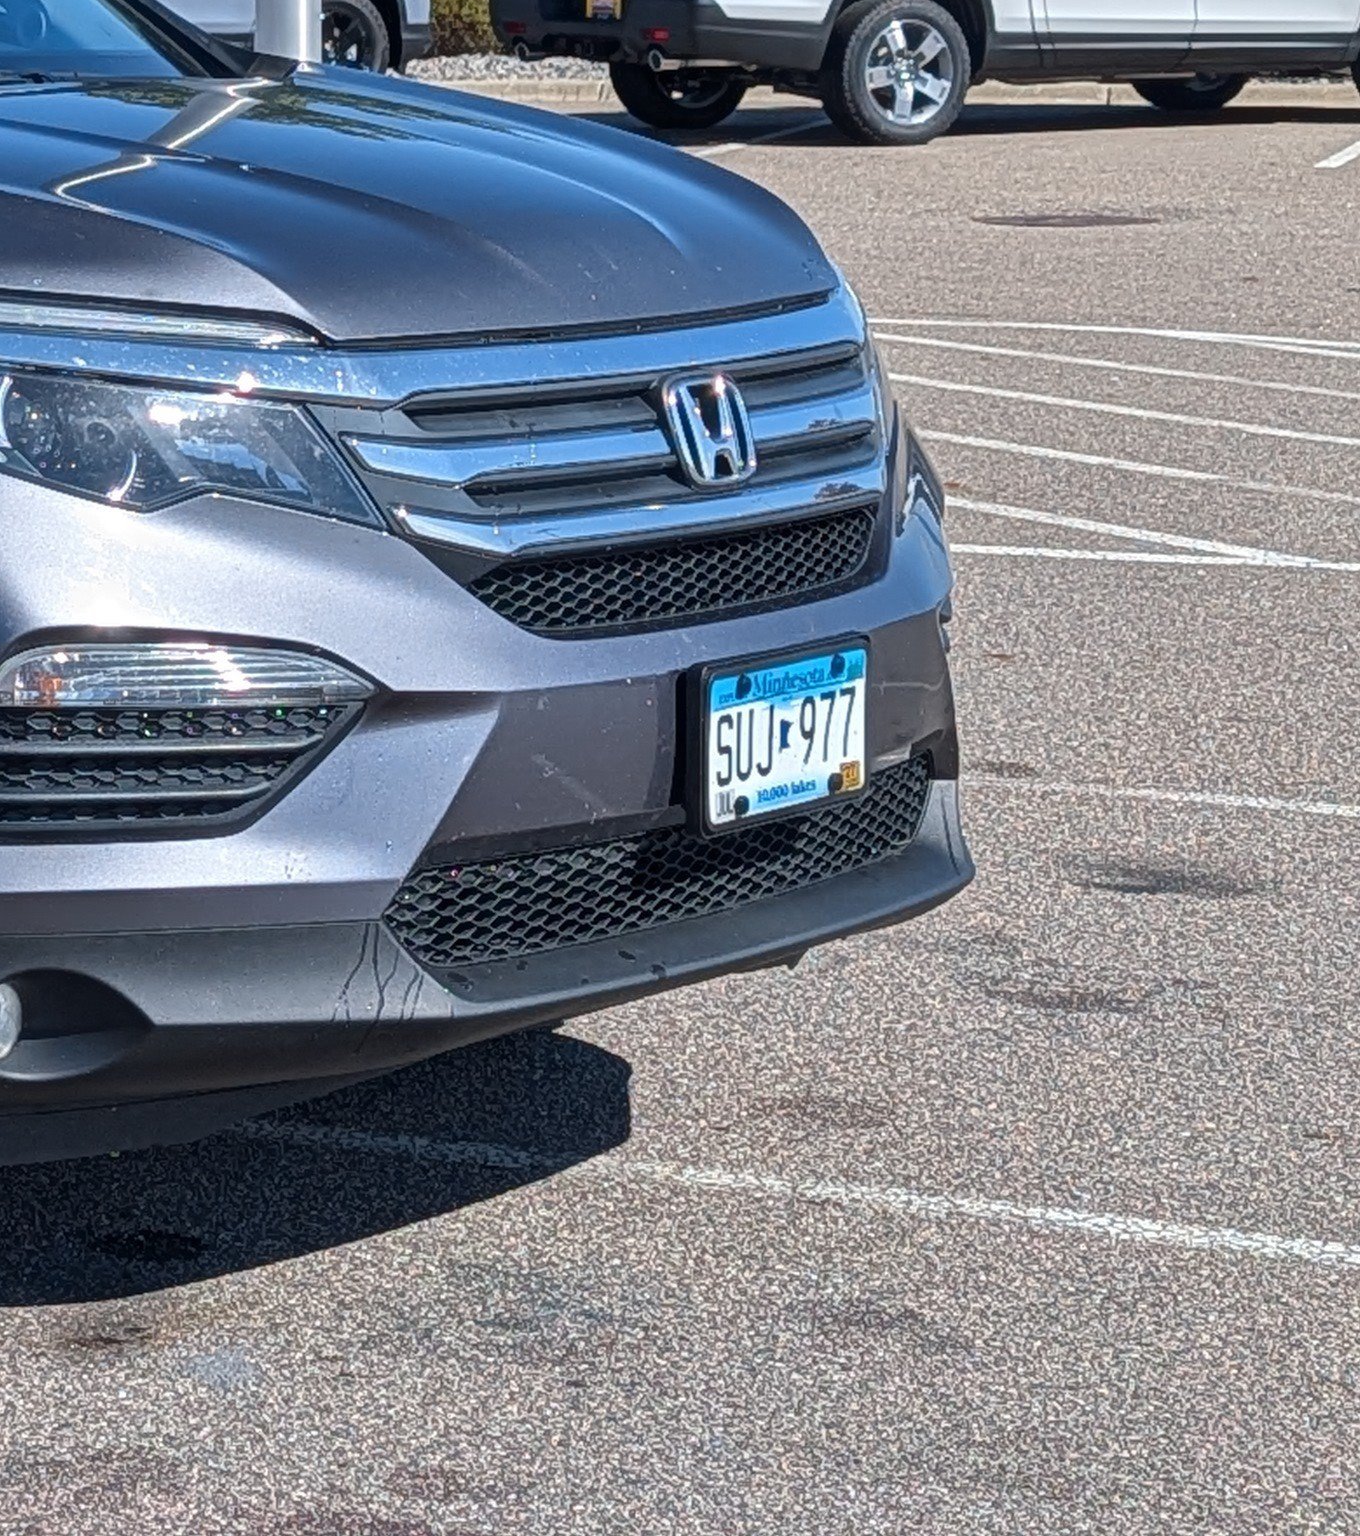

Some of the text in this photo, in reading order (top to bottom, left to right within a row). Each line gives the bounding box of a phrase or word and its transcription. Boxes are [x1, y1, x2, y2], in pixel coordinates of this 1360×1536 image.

[752, 667, 825, 696] Minnesota
[716, 686, 856, 788] SUJ 977
